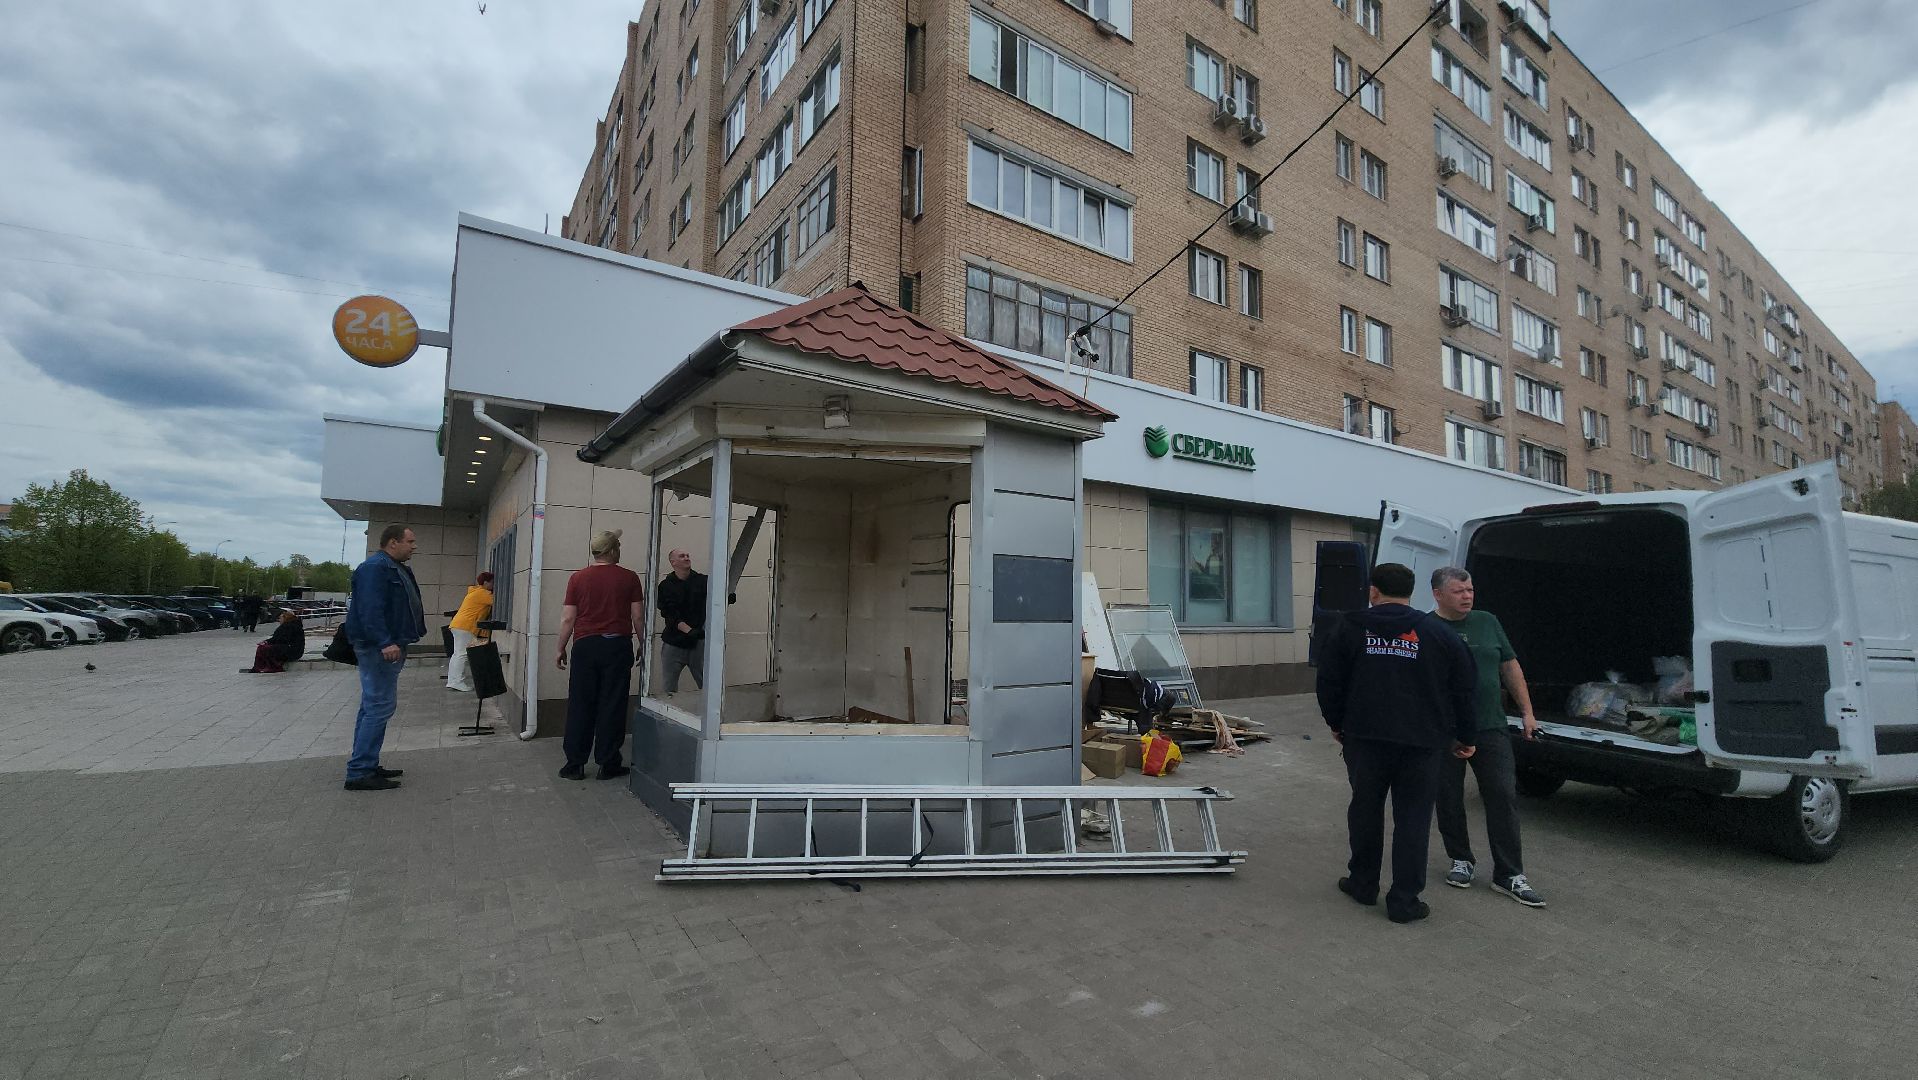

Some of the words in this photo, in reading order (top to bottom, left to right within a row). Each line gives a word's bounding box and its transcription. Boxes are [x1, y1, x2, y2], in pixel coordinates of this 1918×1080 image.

[345, 308, 390, 336] 24
[346, 336, 393, 350] ЧАСА
[1171, 433, 1256, 466] СБЕРБАНК
[1366, 637, 1419, 650] DIVERS
[1366, 647, 1387, 655] SHARM
